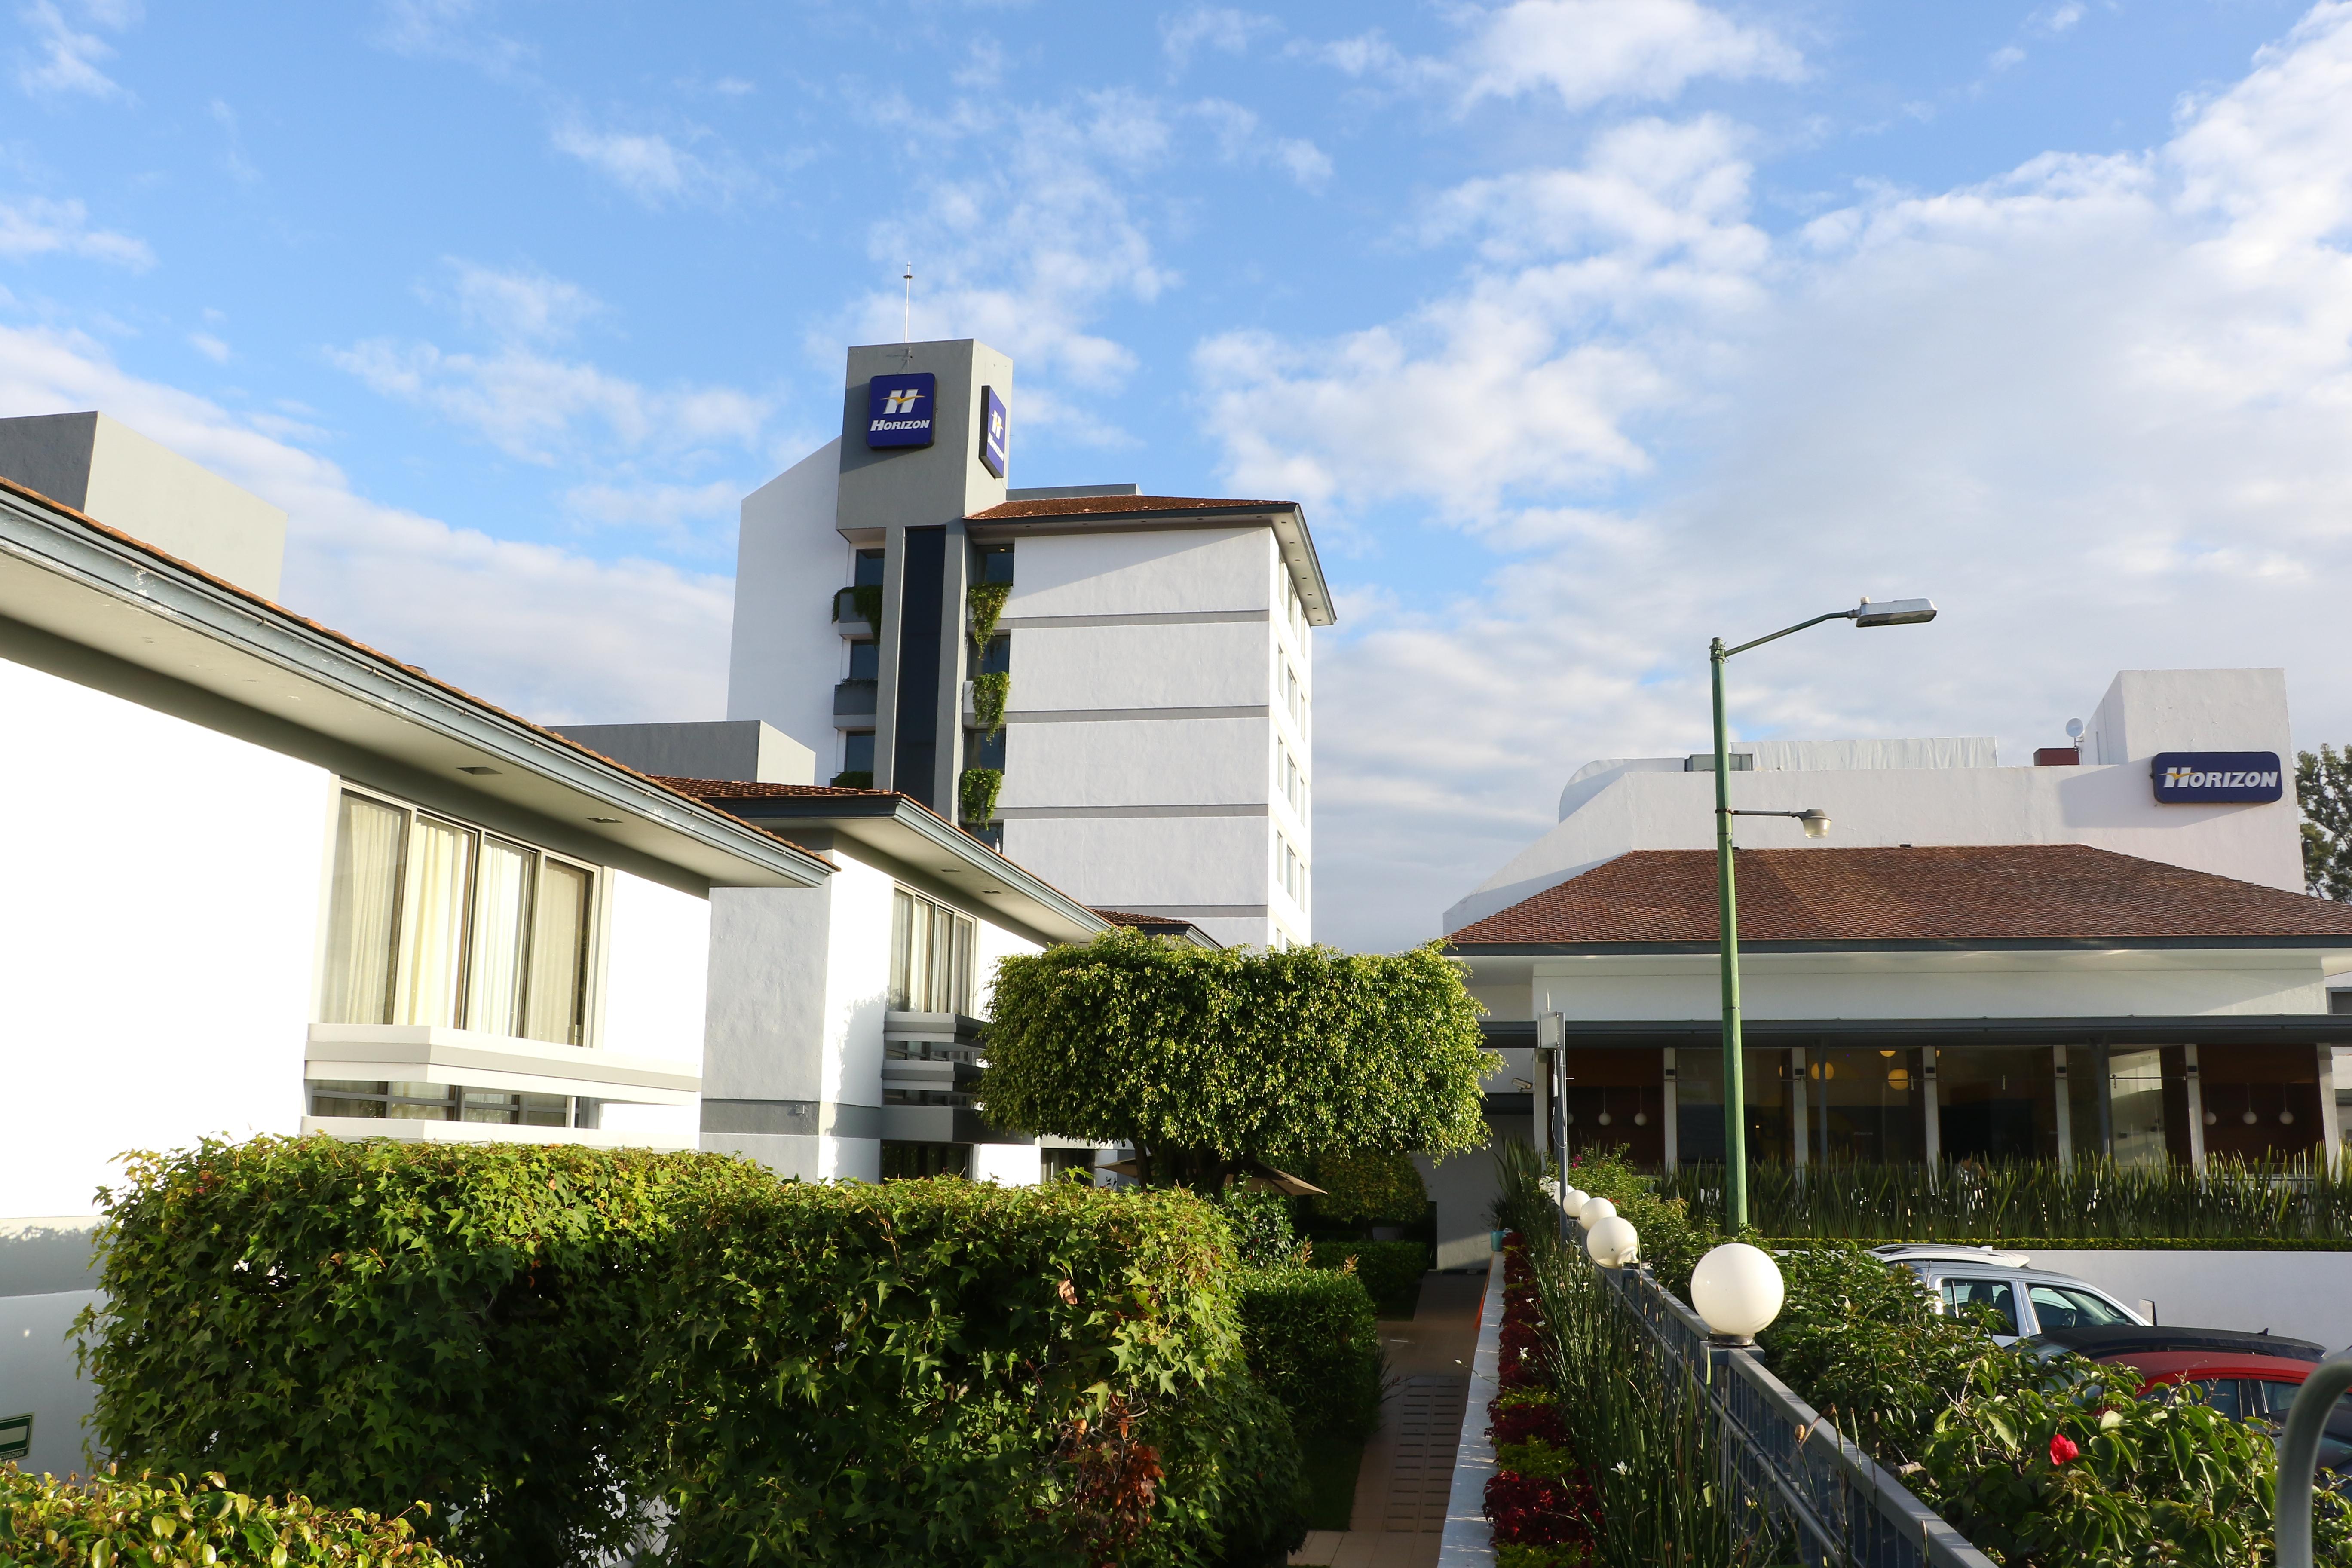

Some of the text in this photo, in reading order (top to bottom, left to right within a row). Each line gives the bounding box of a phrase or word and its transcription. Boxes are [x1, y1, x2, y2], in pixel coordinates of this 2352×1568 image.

[870, 420, 930, 431] HORIZON
[988, 432, 1004, 461] HORIZON
[2163, 767, 2278, 788] HORIZON
